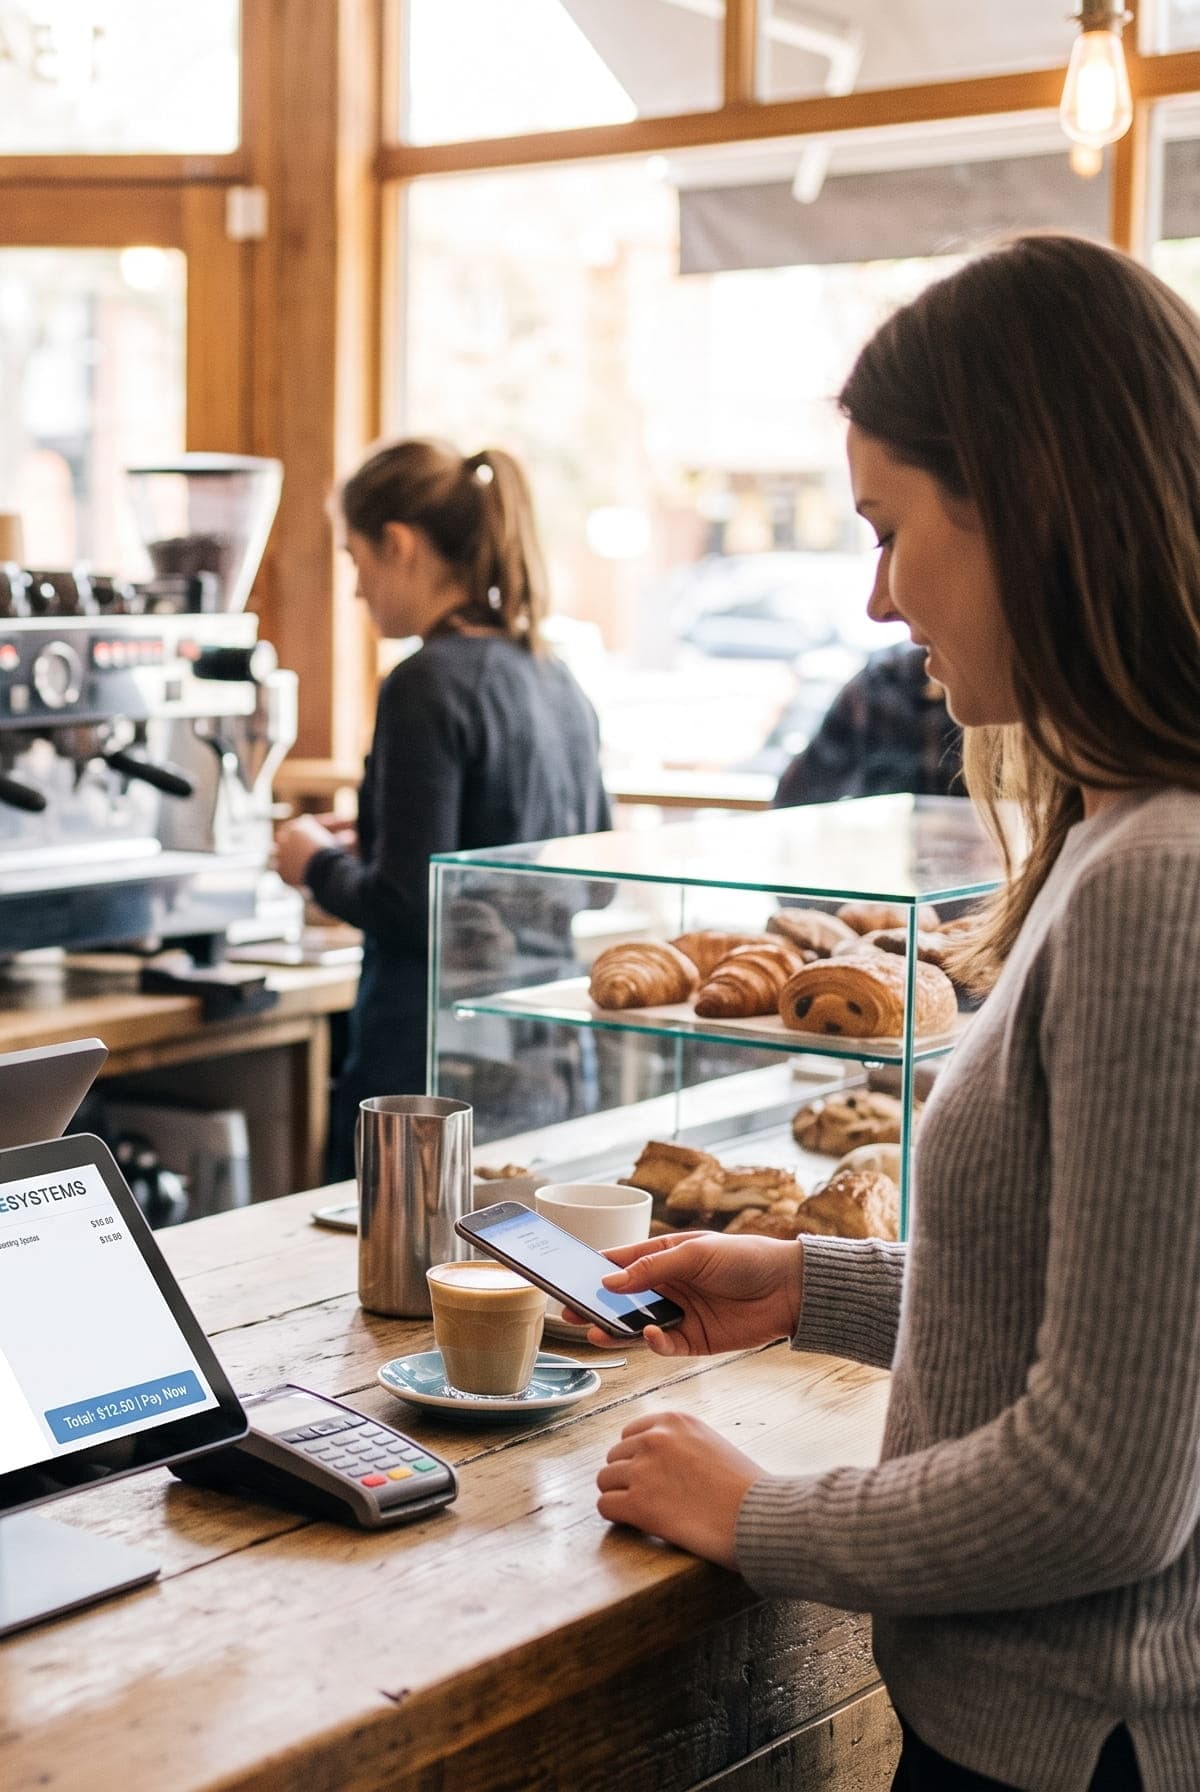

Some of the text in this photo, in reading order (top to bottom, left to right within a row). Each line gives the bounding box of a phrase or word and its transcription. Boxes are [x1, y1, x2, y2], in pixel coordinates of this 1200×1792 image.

[96, 1400, 134, 1420] $12.50
[141, 1394, 162, 1406] Pay
[162, 1384, 188, 1400] Now
